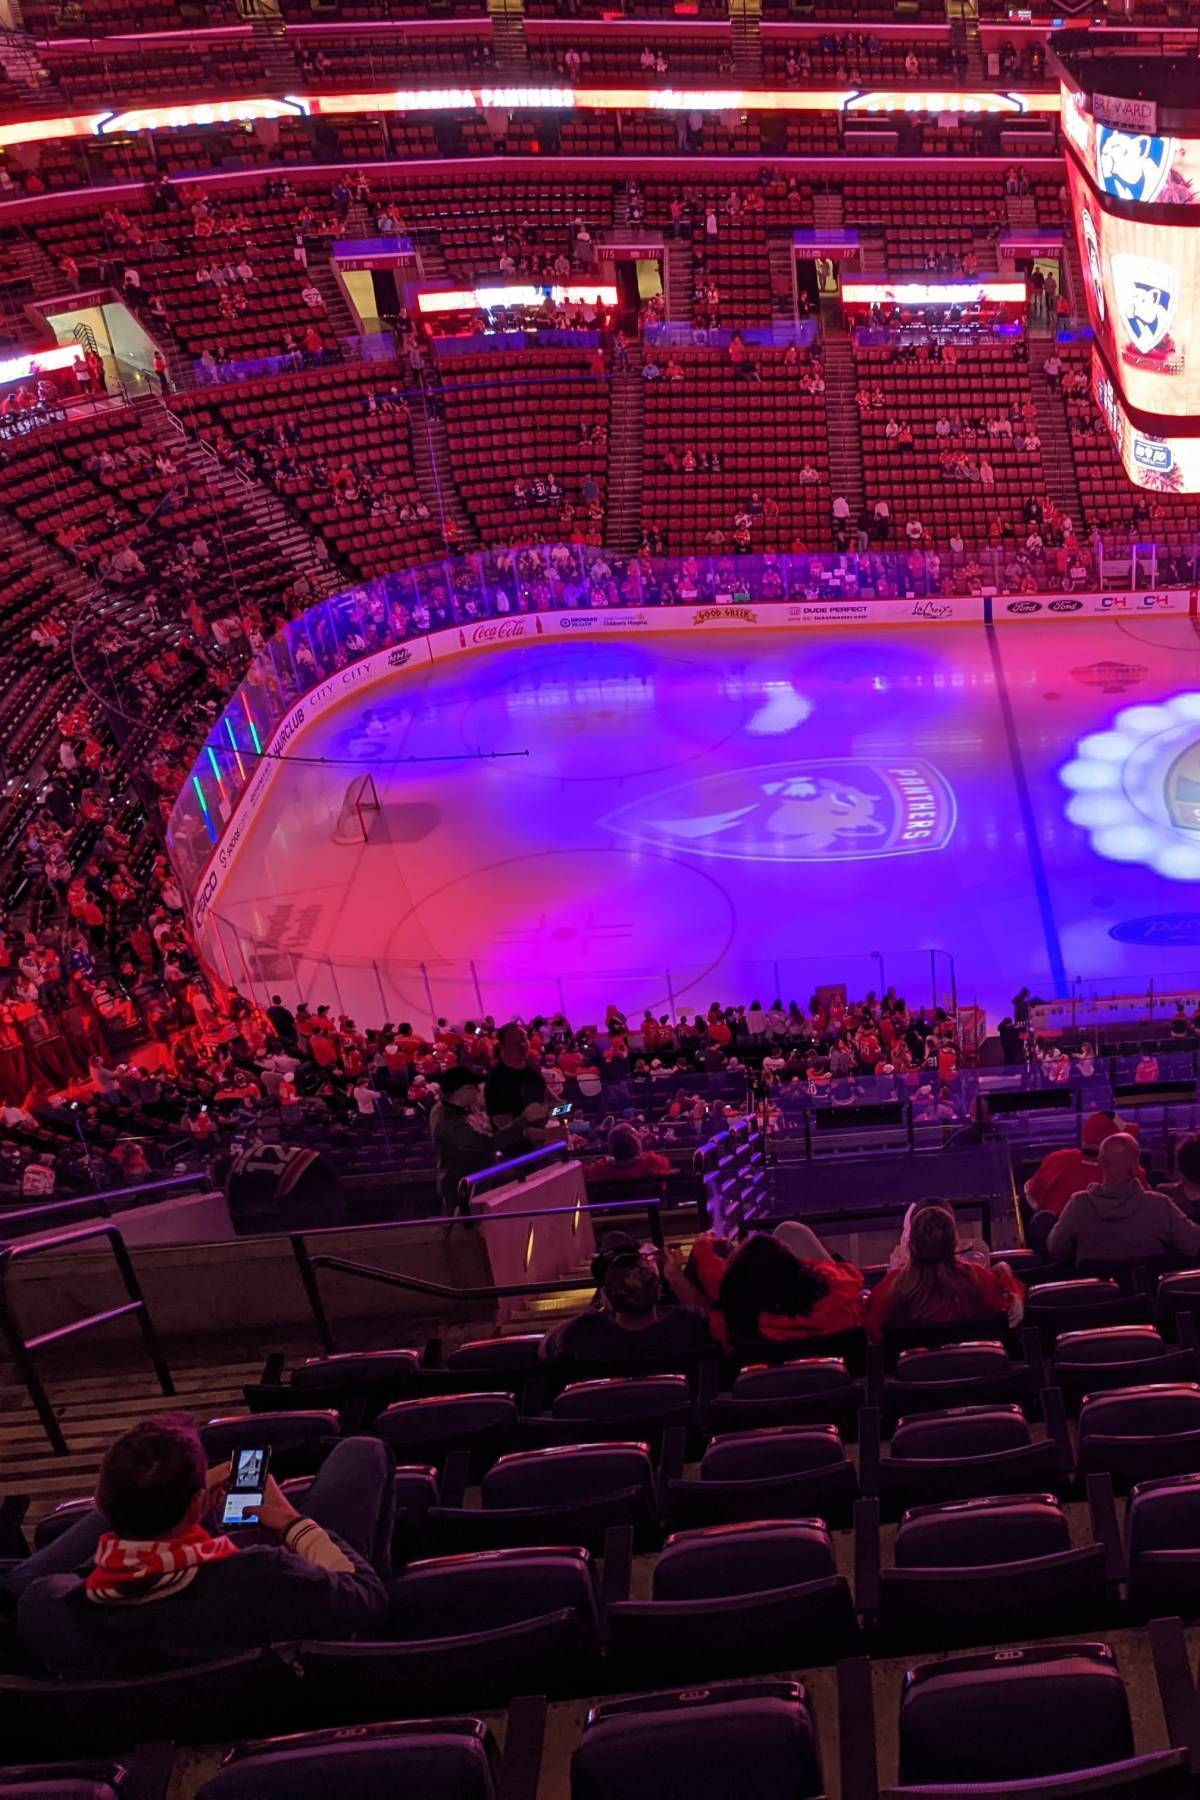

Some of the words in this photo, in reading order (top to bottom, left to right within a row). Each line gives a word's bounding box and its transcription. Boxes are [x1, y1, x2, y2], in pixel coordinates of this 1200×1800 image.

[698, 608, 723, 619] GOOD
[725, 608, 750, 618] GREEK
[1012, 602, 1038, 612] Ford
[1052, 600, 1078, 610] Ford
[342, 662, 372, 684] CITY
[309, 682, 334, 706] CITY
[272, 708, 305, 758] HAIRCLUB
[888, 769, 936, 839] PANTHERS
